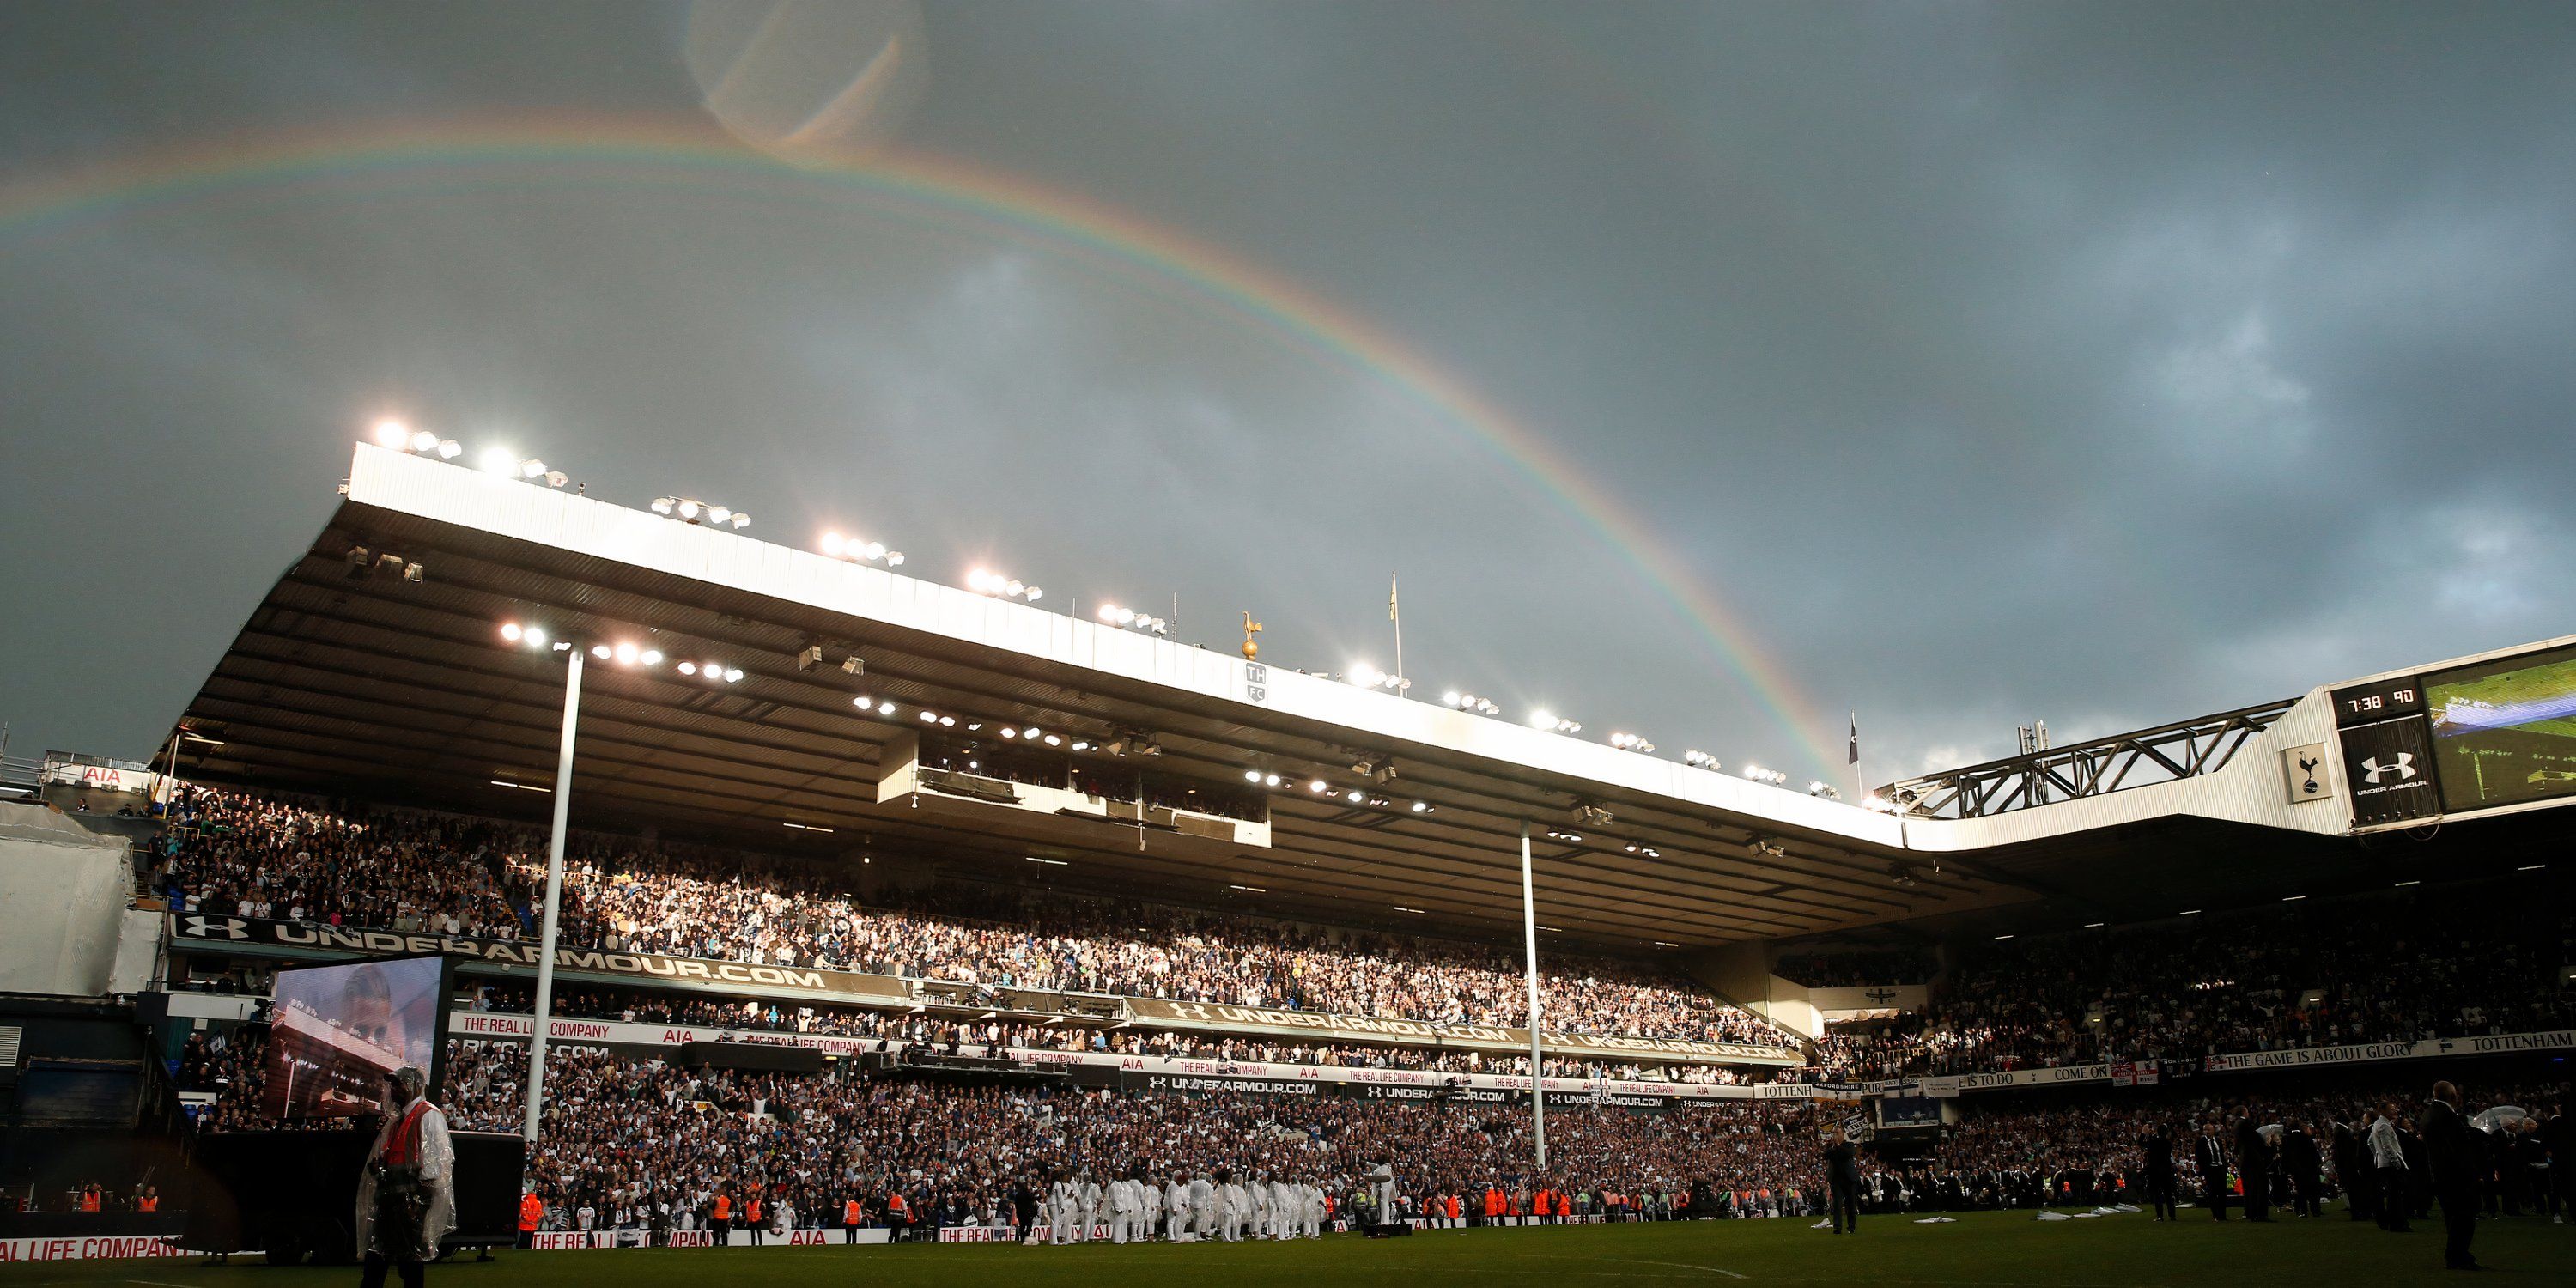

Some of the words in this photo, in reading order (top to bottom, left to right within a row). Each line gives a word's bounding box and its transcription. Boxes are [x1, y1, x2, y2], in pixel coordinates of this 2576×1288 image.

[2348, 696, 2382, 712] 7:38
[2393, 690, 2414, 703] 90
[84, 767, 121, 783] AIA
[2357, 787, 2387, 796] UNDER
[2389, 780, 2428, 791] ARMOUR
[464, 1017, 486, 1031] THE
[490, 1018, 519, 1033] REAL
[550, 1022, 609, 1039] COMPANY
[663, 1030, 694, 1042] AIA
[2471, 1032, 2573, 1051] TOTTENHAM
[2226, 1055, 2251, 1068] THE
[2255, 1052, 2294, 1066] GAME
[2297, 1050, 2310, 1063] IS
[2314, 1047, 2361, 1062] ABOUT
[2366, 1042, 2413, 1059] GLORY
[1122, 1058, 1143, 1070] AIA
[1181, 1062, 1194, 1072] THE
[1196, 1063, 1213, 1073] REAL
[1234, 1066, 1267, 1076] OMPANY
[1300, 1067, 1318, 1078] AIA
[1350, 1071, 1362, 1080] THE
[1363, 1072, 1379, 1081] REAL
[1380, 1072, 1393, 1082] LIFE
[1394, 1073, 1424, 1084] COMPANY
[1968, 1077, 1977, 1086] IS
[1979, 1075, 1994, 1085] TO
[1997, 1073, 2013, 1084] DO
[2055, 1066, 2087, 1080] COME
[2091, 1065, 2108, 1078] ON
[1495, 1078, 1505, 1087] THE
[1506, 1079, 1519, 1088] REAL
[1521, 1079, 1532, 1088] LIFE
[1620, 1084, 1629, 1092] THE
[1630, 1084, 1642, 1093] REAL
[1643, 1084, 1652, 1093] LIFE
[1653, 1085, 1675, 1094] COMPANY
[1697, 1086, 1709, 1095] AIA
[532, 1234, 561, 1250] THE
[790, 1230, 828, 1245] AIA
[941, 1230, 963, 1242] THE
[28, 1240, 77, 1261] LIFE
